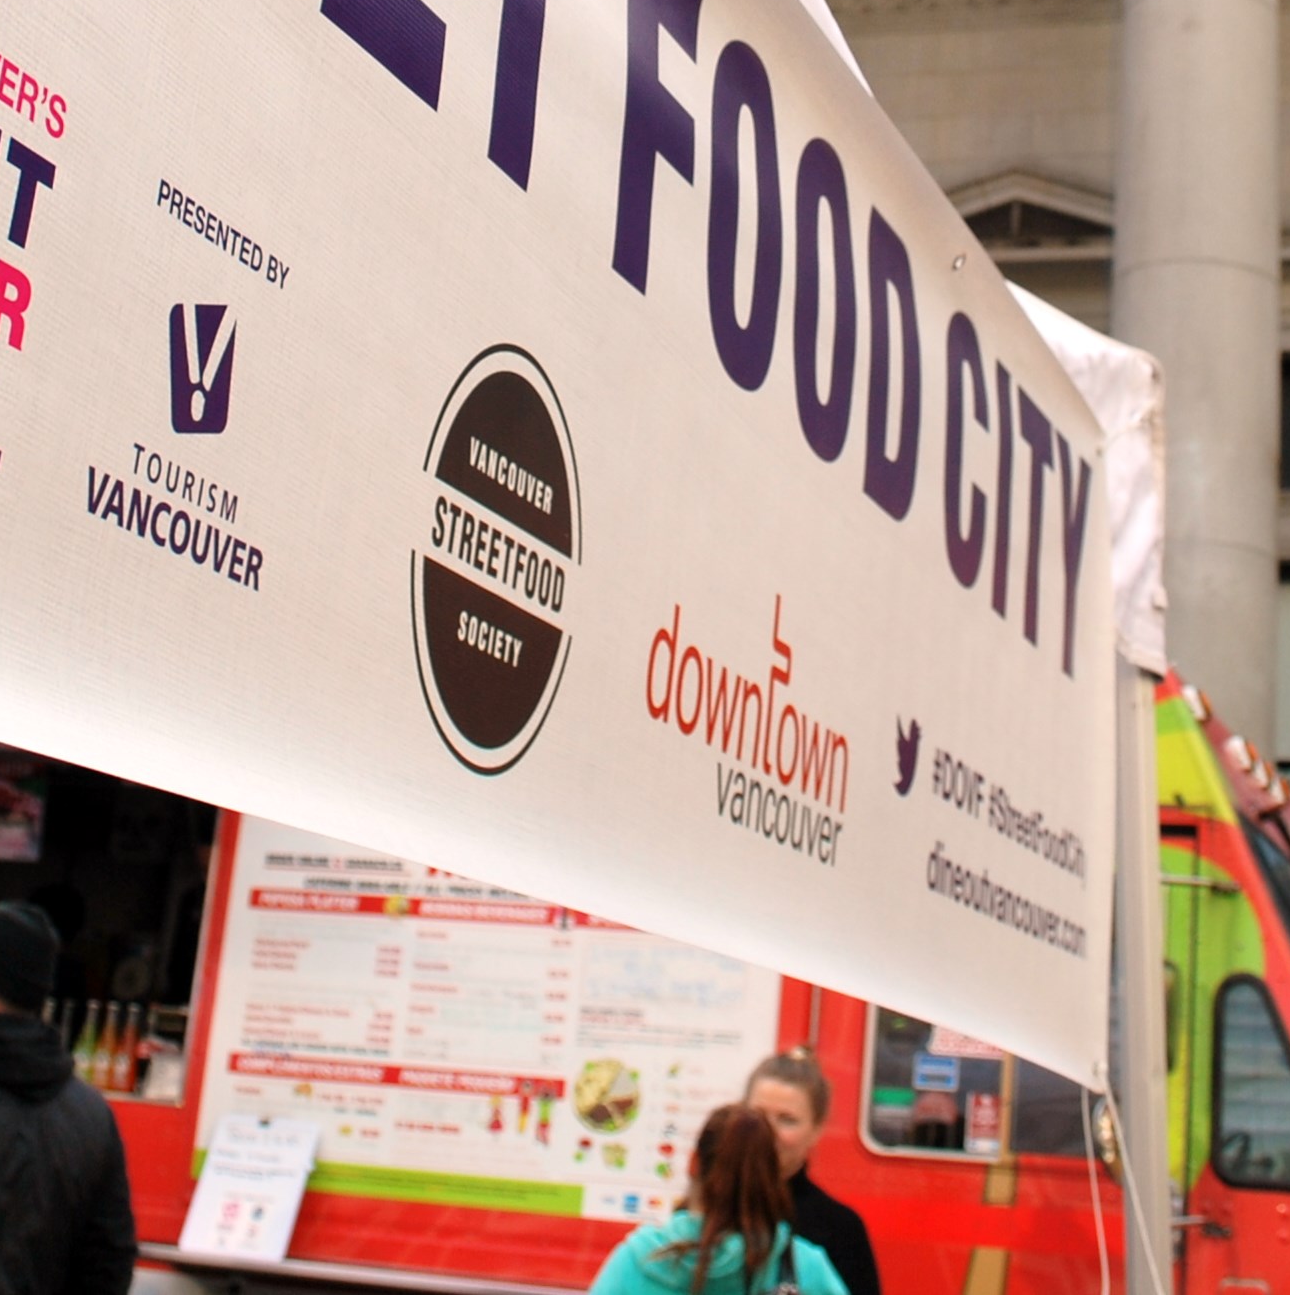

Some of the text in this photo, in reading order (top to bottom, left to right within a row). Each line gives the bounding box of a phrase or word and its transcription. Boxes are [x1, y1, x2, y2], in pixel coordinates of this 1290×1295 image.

[156, 179, 290, 290] PRESENTED BY
[87, 466, 264, 592] VANCOUVER
[133, 443, 239, 525] TOURISM
[470, 436, 553, 515] VANCOUVER
[942, 311, 1092, 680] CITY
[431, 496, 567, 614] STREETFOOD
[456, 611, 523, 668] SOCIETY
[646, 593, 849, 815] downtown
[717, 761, 843, 867] vancouver
[927, 839, 1087, 958] dineoutvancouver.com
